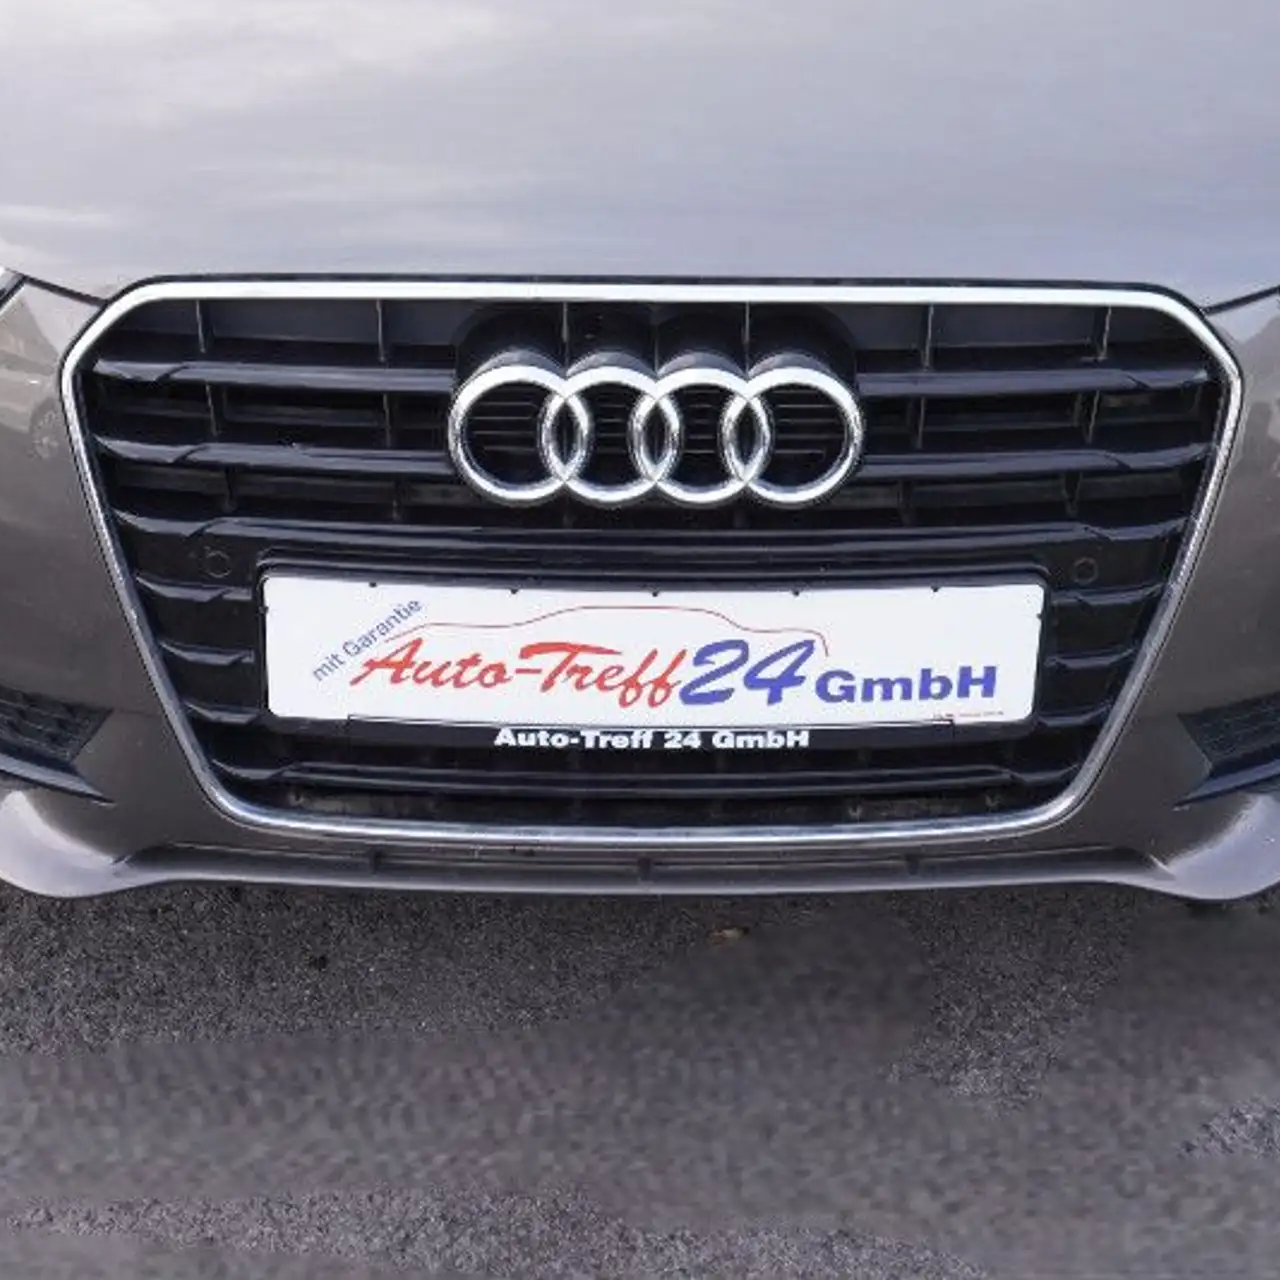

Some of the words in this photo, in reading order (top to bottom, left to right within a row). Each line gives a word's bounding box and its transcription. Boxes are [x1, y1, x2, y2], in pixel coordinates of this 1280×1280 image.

[312, 639, 345, 682] mit
[342, 599, 421, 658] Garantie
[815, 665, 998, 704] GmbH
[494, 726, 657, 749] Auto-Treff
[662, 729, 702, 750] 24
[711, 728, 810, 749] GmbH
